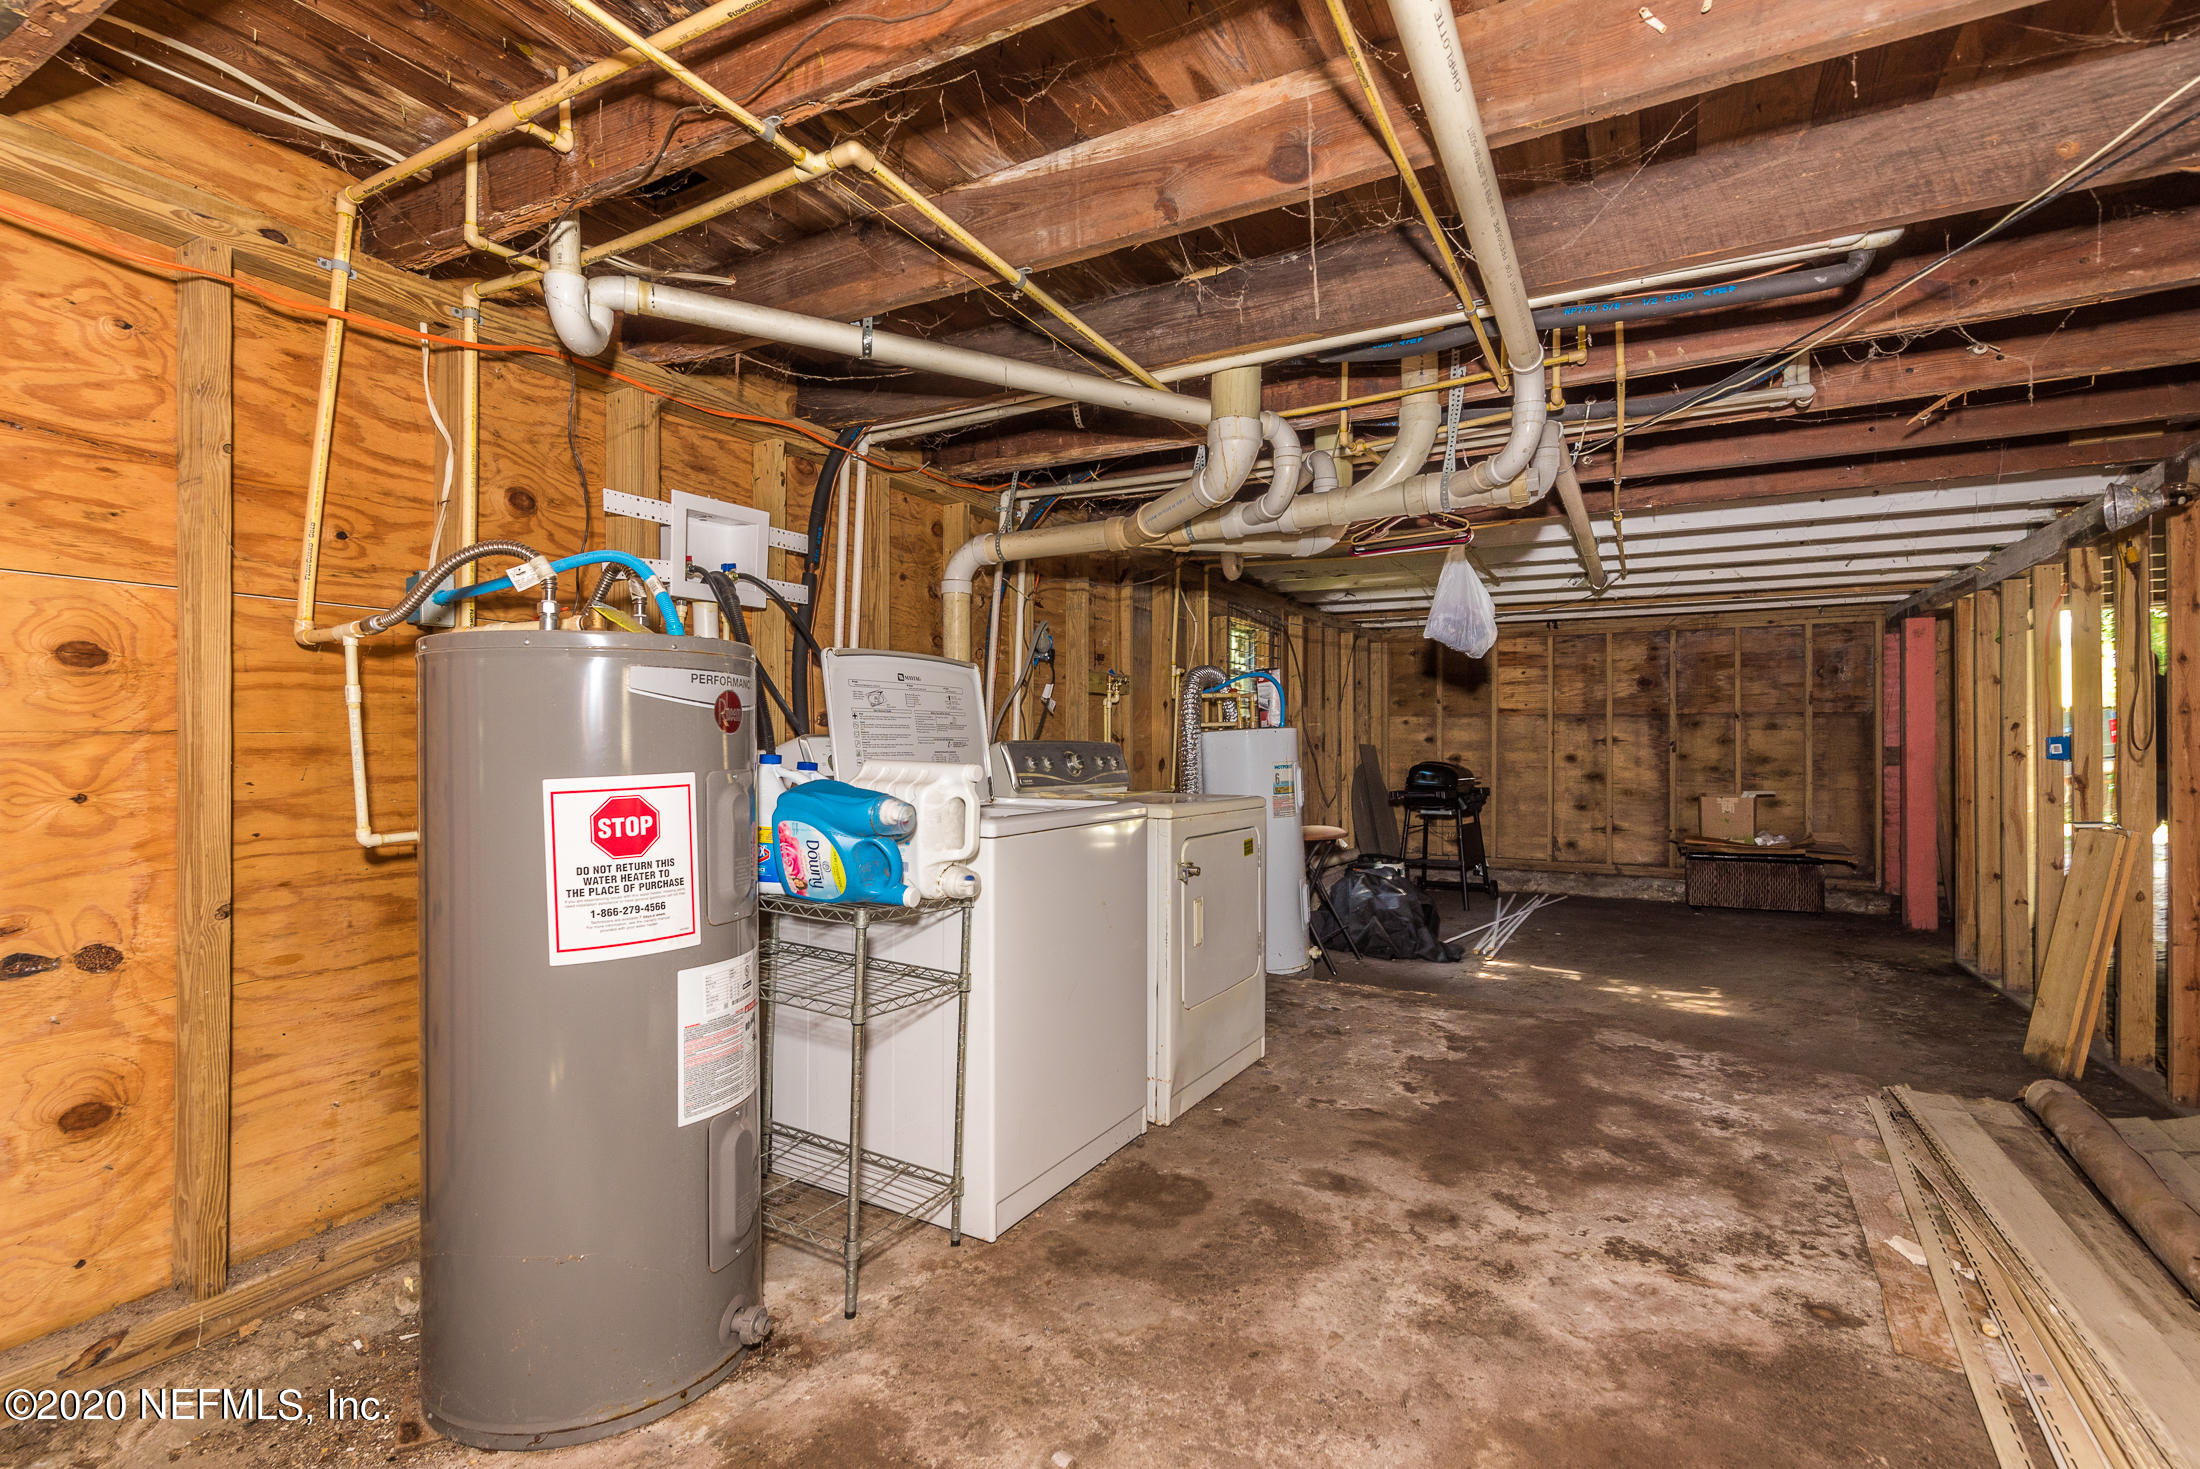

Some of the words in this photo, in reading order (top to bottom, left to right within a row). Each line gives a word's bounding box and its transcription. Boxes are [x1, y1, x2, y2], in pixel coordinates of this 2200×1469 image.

[1434, 8, 1463, 93] CHARLOTTE
[1642, 297, 1659, 306] 1/2
[690, 673, 752, 690] PERFORMANC
[597, 816, 653, 839] STOP
[576, 866, 590, 876] DO
[593, 864, 613, 875] NOT
[615, 861, 653, 872] RETURN
[655, 858, 675, 869] THIS
[806, 840, 824, 889] Downy
[583, 875, 618, 886] WATER
[620, 871, 656, 883] HEATER
[659, 869, 670, 879] TO
[566, 888, 585, 899] THE
[588, 884, 620, 897] PLACE
[623, 883, 636, 893] OF
[638, 877, 685, 892] PURCHASE
[590, 901, 667, 919] 1-866-279-4566
